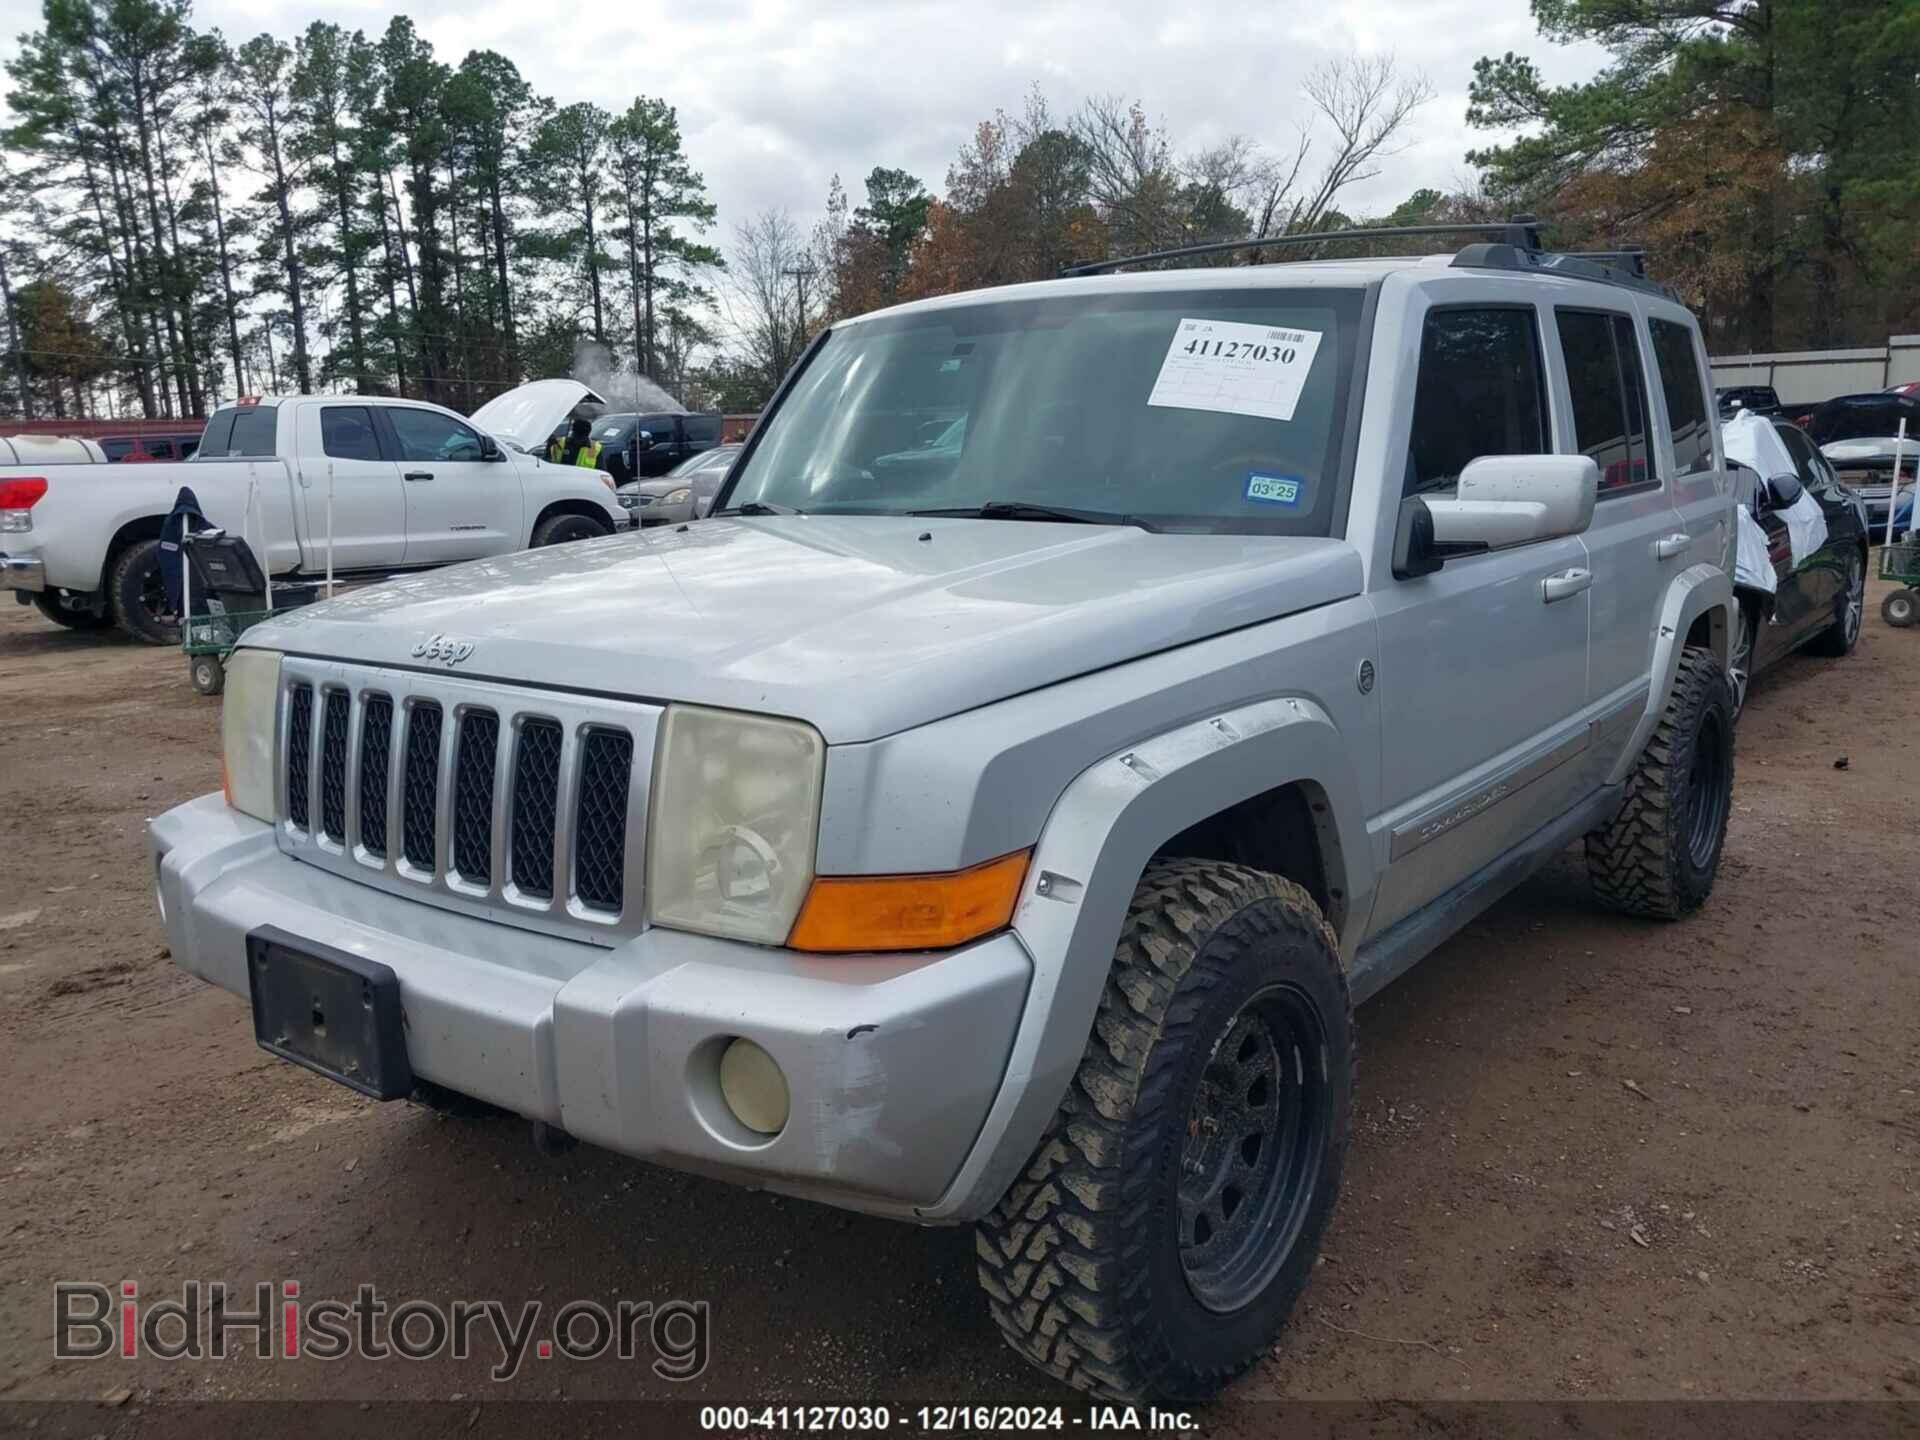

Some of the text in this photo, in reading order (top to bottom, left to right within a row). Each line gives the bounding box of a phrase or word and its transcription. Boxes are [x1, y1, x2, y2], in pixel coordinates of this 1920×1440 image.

[1183, 339, 1296, 364] 41127030
[1252, 483, 1270, 496] 03
[1276, 485, 1295, 498] 25
[411, 632, 475, 667] Jeep
